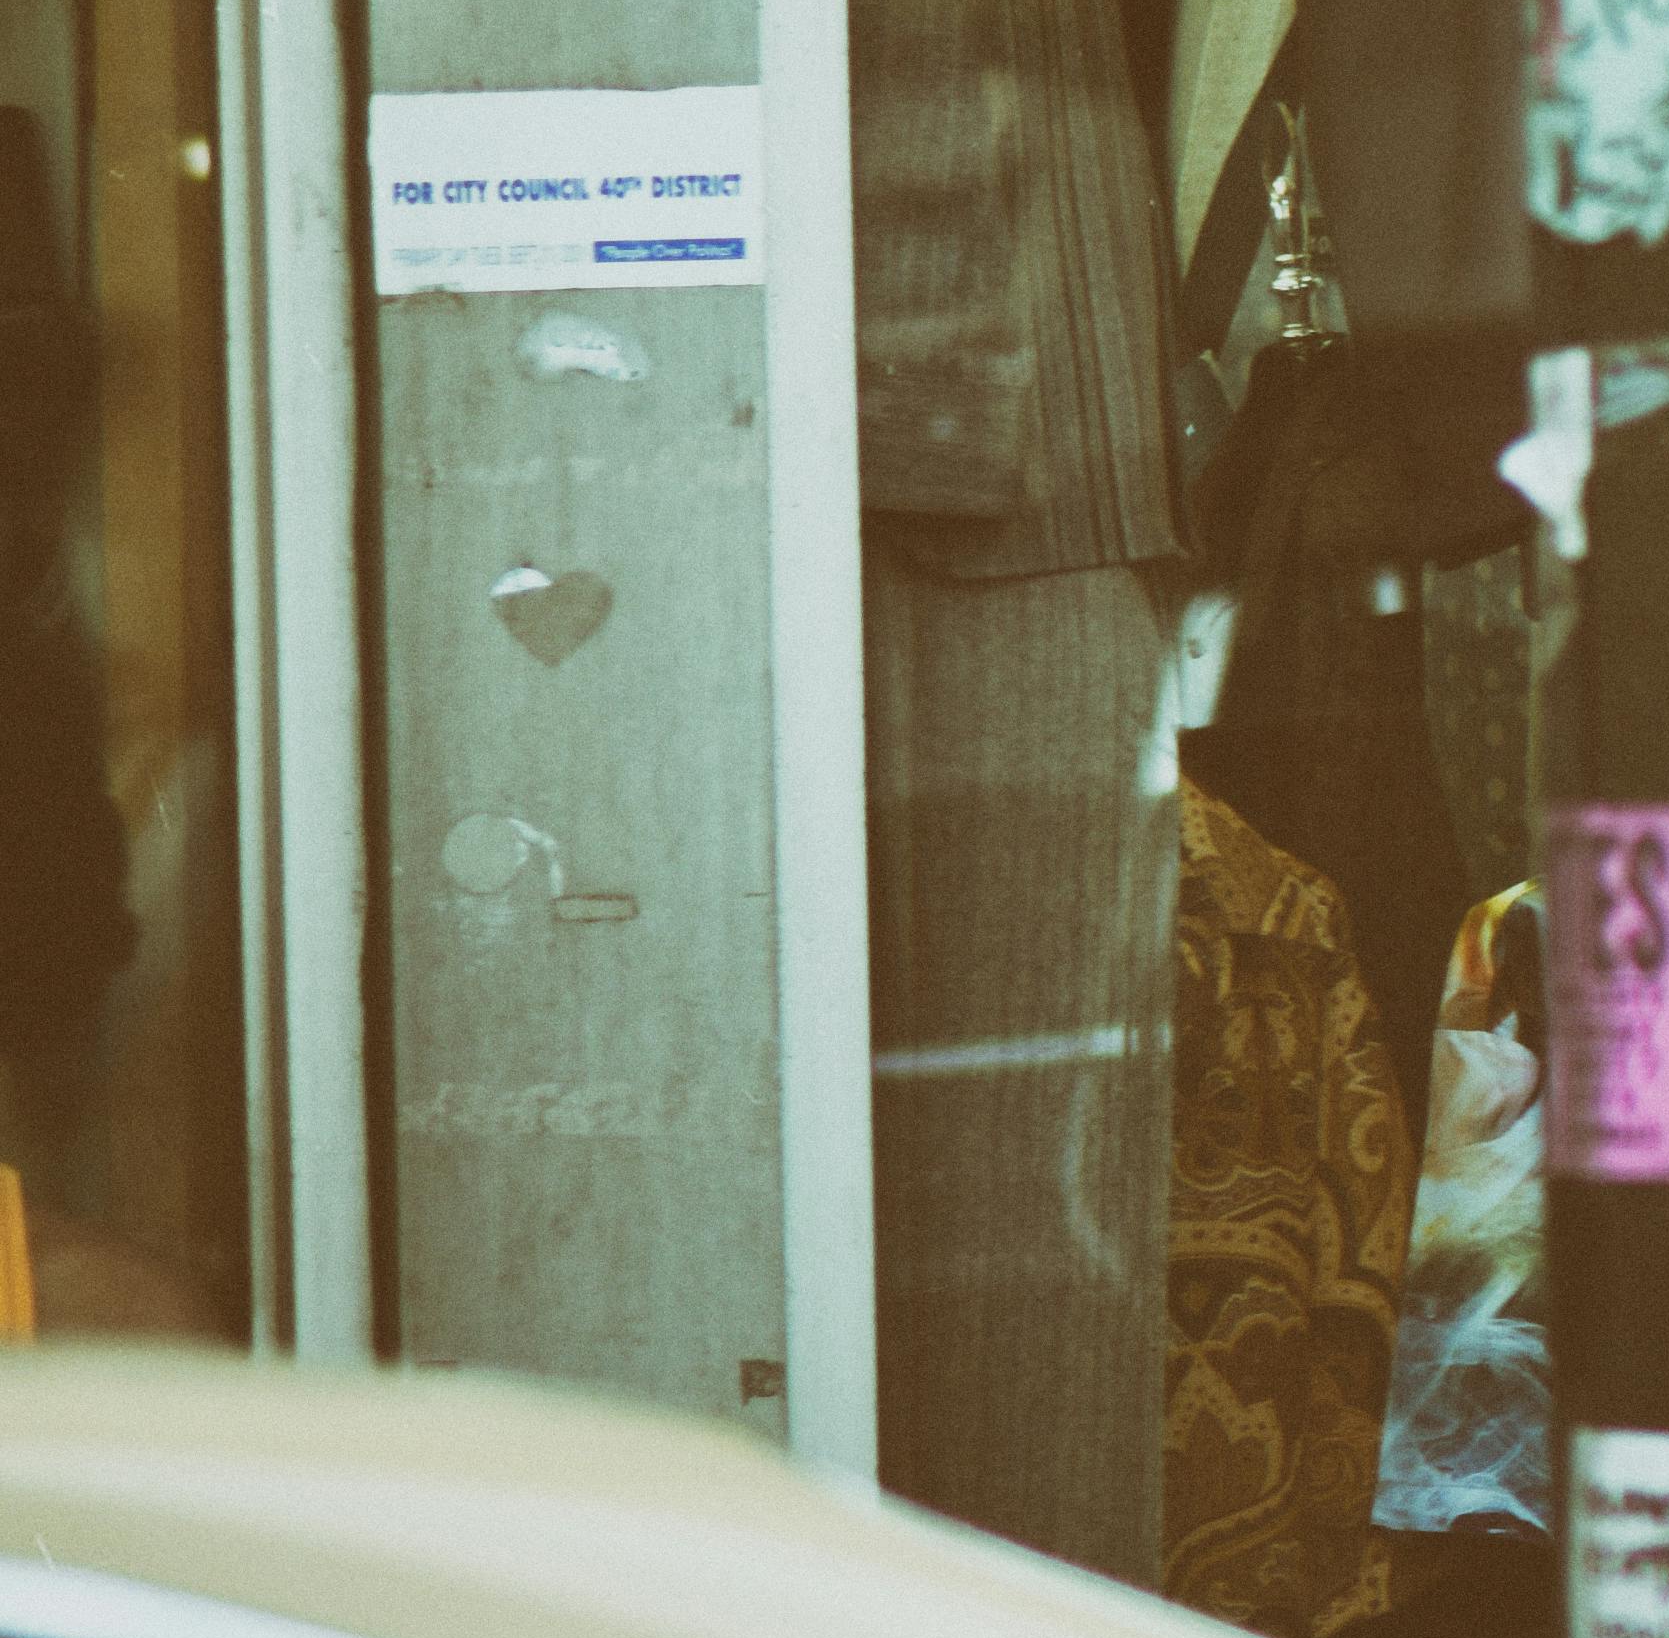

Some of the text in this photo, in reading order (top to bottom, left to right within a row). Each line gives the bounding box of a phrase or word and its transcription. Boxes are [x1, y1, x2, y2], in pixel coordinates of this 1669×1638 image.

[392, 181, 435, 206] FOR
[442, 179, 487, 204] CITY
[498, 177, 590, 202] COUNCIL
[650, 173, 742, 199] DISTRICT
